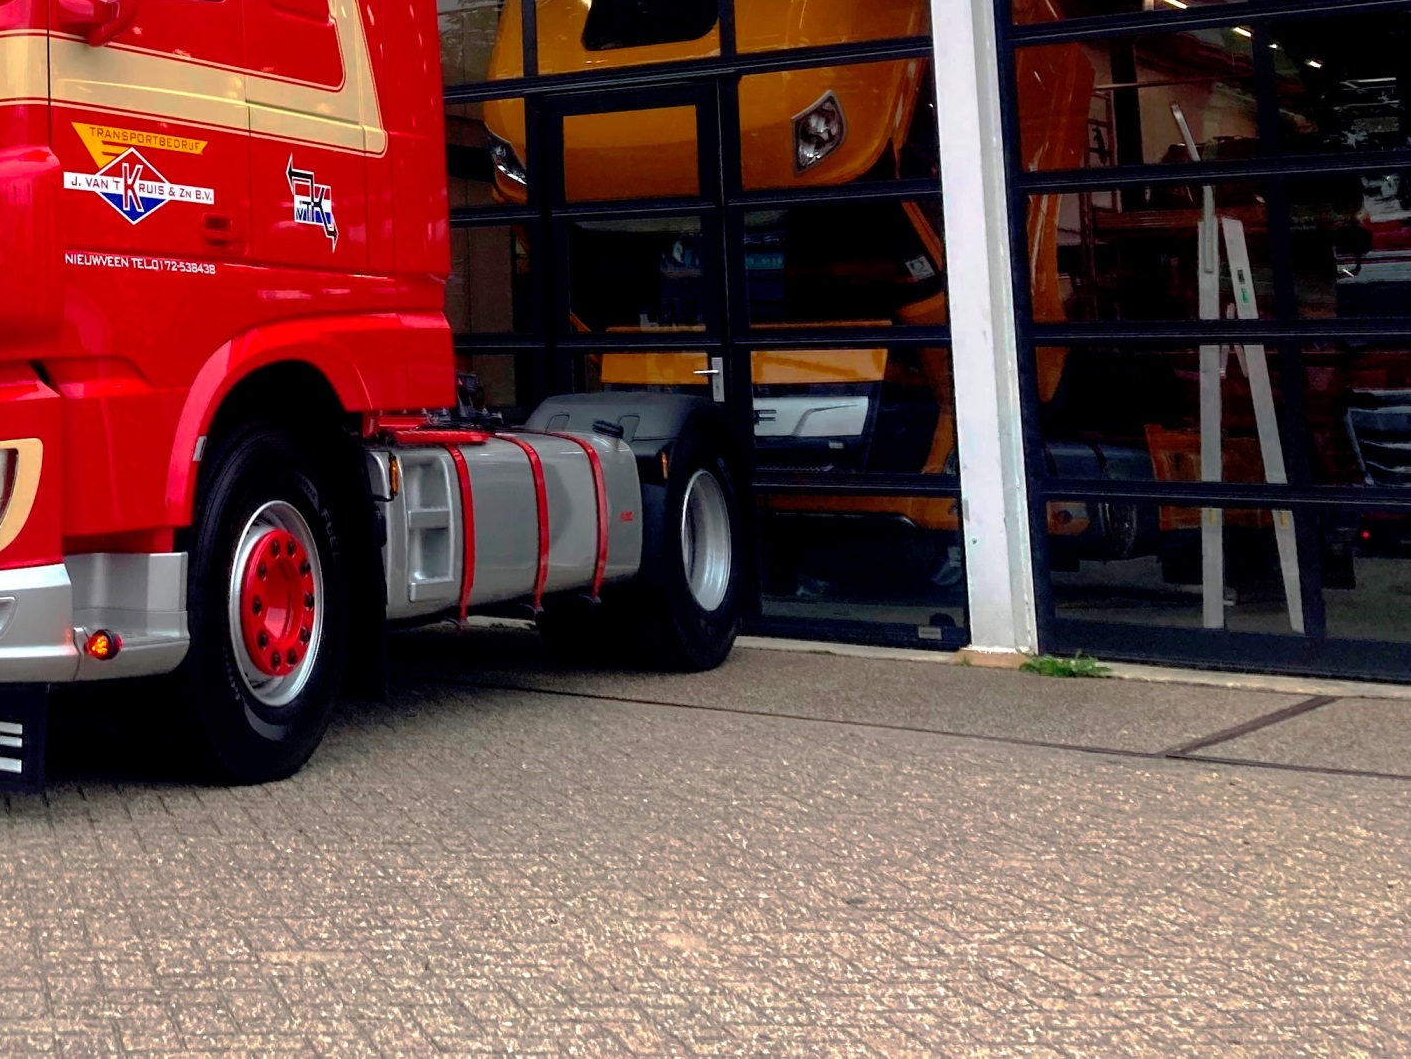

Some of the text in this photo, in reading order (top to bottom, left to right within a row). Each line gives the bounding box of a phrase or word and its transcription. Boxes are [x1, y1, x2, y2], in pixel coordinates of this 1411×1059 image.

[89, 126, 200, 152] TRANSPORTBEDRIJF
[71, 176, 82, 187] J.
[85, 177, 109, 190] VAN
[168, 186, 176, 197] &
[195, 189, 212, 202] B.V.
[64, 253, 129, 268] NIEUWVEEN
